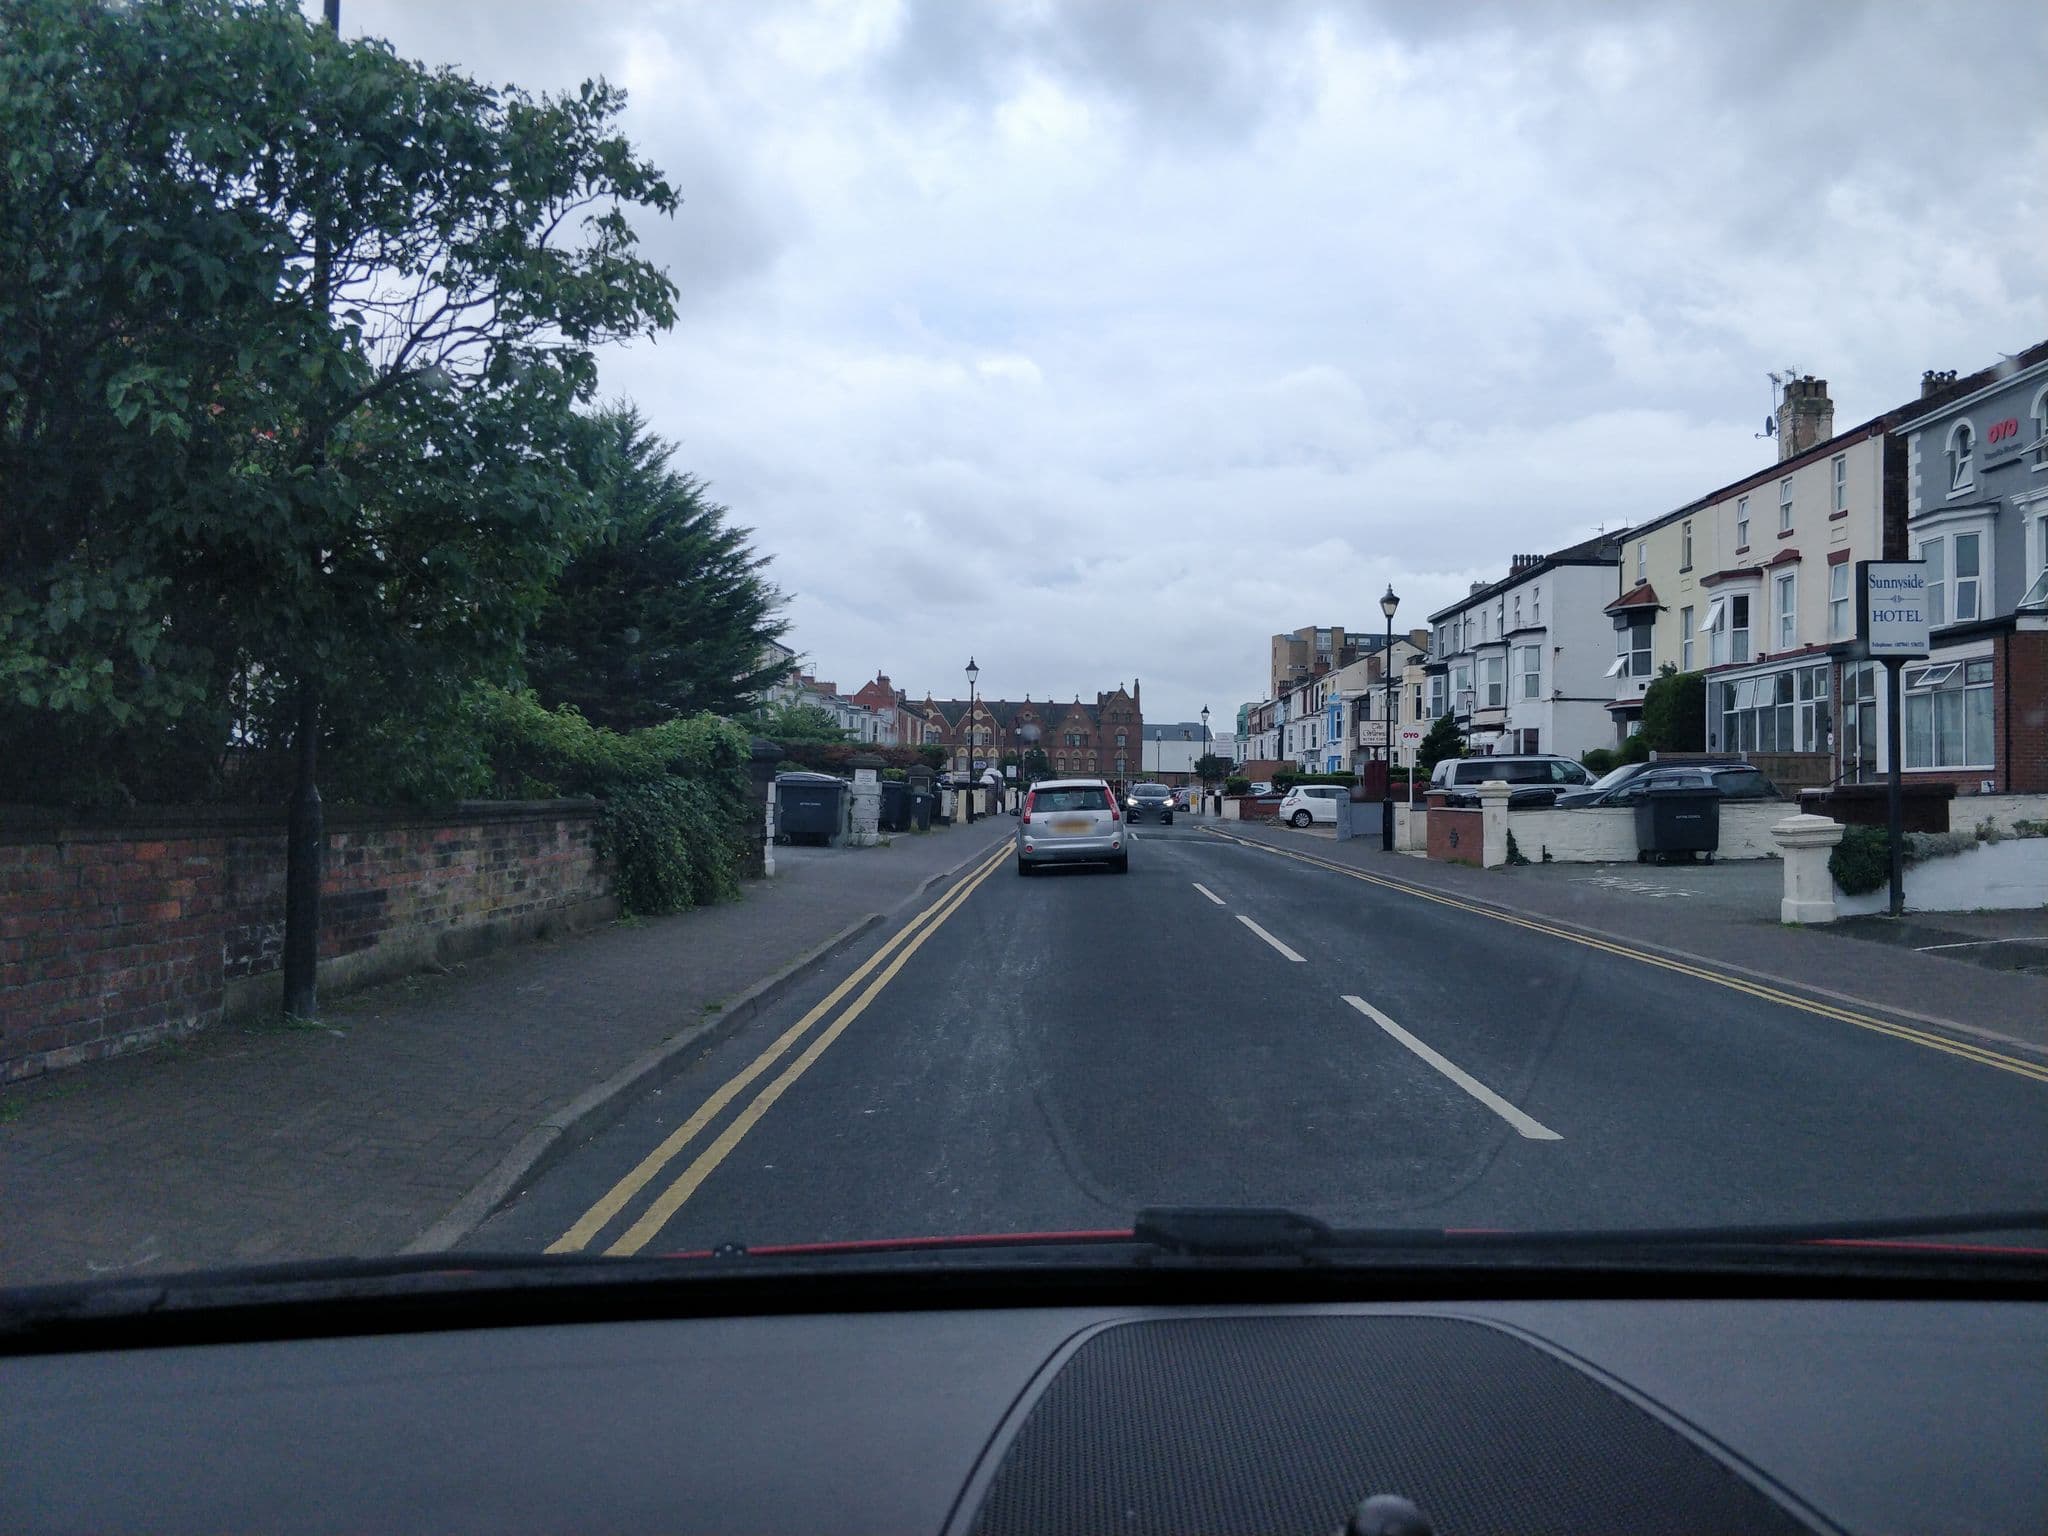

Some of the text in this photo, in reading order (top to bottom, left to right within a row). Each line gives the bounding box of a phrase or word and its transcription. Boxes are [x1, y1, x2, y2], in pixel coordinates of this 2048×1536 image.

[1988, 419, 2018, 444] OYO
[1869, 573, 1924, 590] Sunnyside
[1873, 610, 1923, 622] HOTEL
